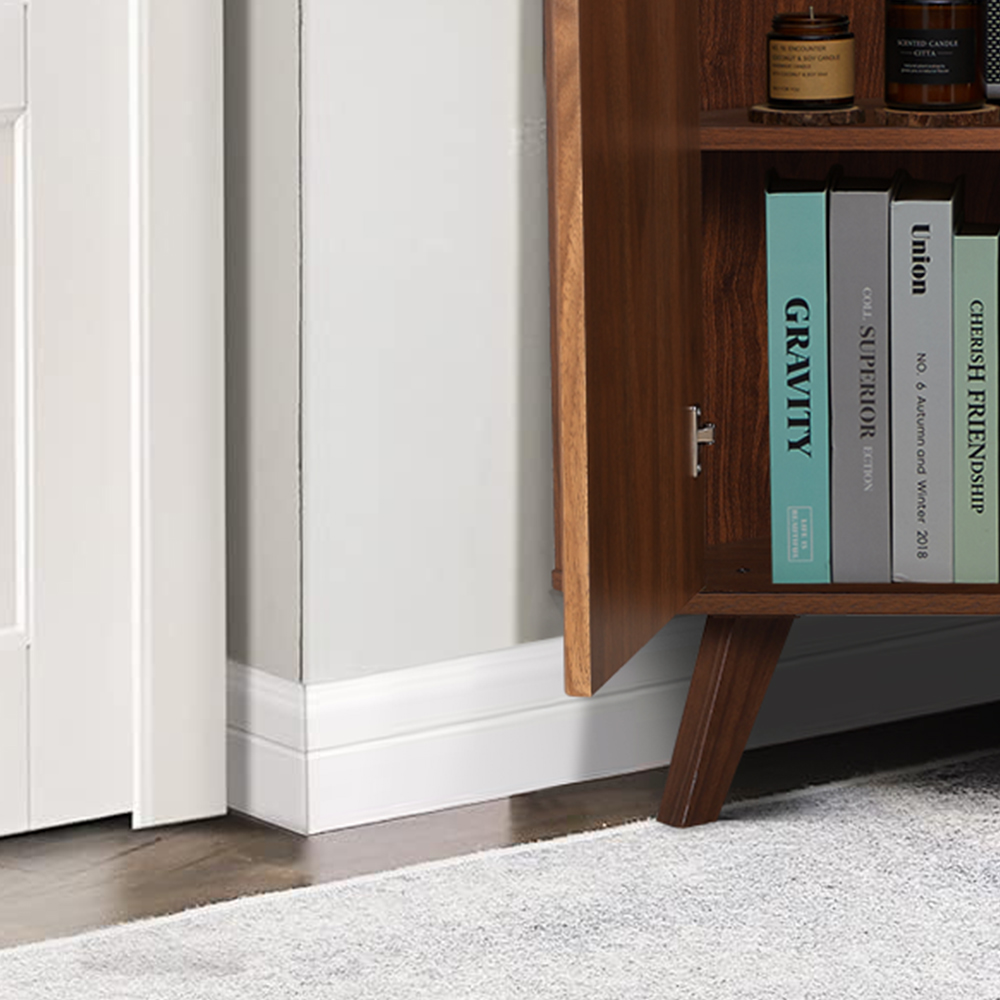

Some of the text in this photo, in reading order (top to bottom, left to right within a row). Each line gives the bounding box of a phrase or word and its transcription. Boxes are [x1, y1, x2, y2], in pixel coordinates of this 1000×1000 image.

[928, 39, 958, 47] CANDLE
[910, 223, 931, 295] Union
[785, 297, 812, 458] GRAVITY
[859, 326, 877, 440] SUPERIOR
[916, 382, 926, 390] 6
[916, 395, 927, 446] Autumn
[967, 300, 987, 514] CHERISH FRIENDSHIP
[862, 446, 873, 492] ECTION
[917, 480, 929, 525] Winter
[917, 530, 929, 560] 2018
